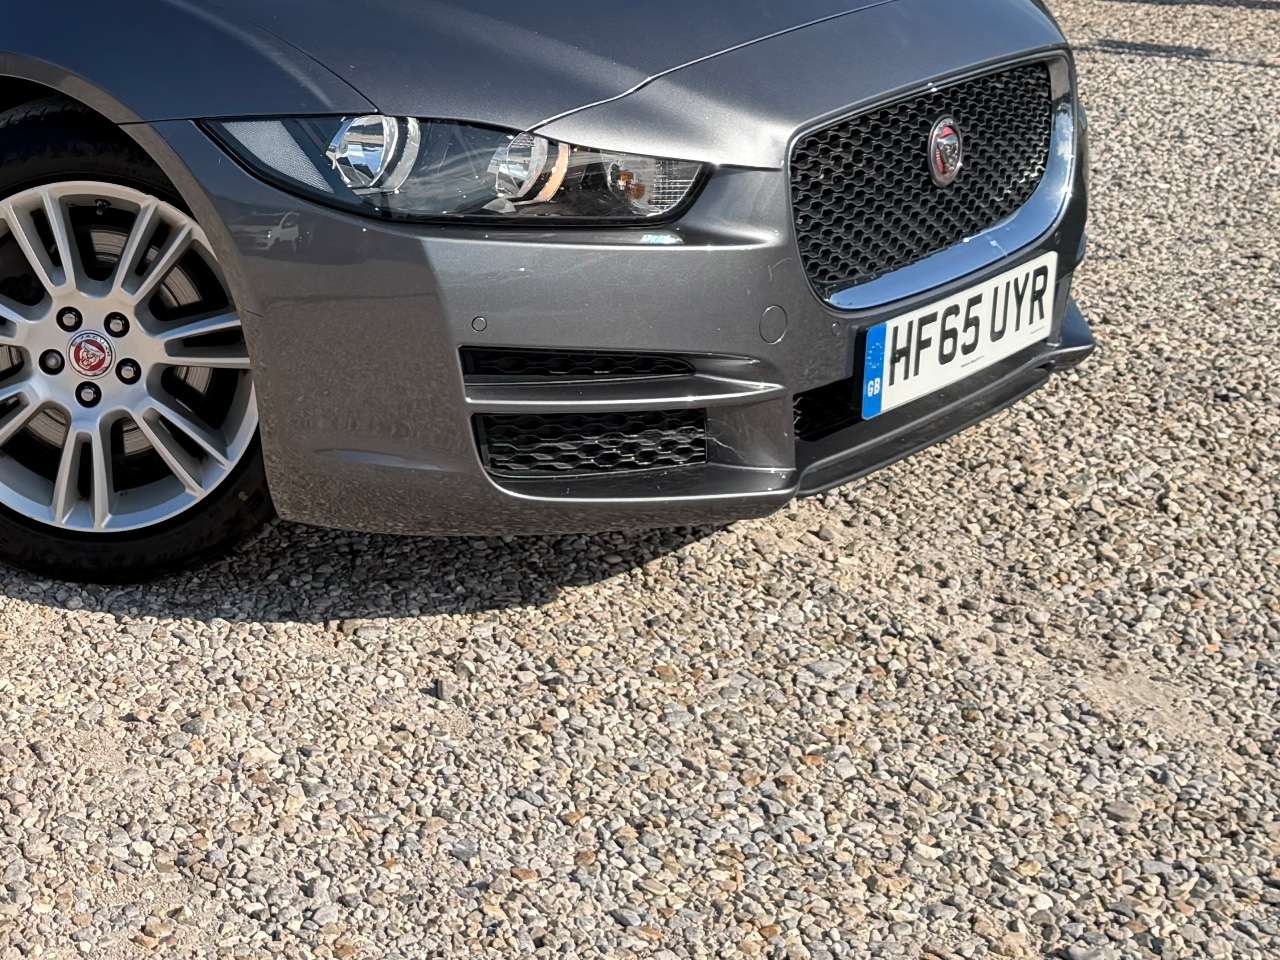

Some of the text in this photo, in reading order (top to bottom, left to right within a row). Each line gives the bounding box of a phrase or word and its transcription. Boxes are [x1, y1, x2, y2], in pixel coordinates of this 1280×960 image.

[888, 264, 1049, 387] HF65 UYR
[867, 377, 881, 398] GB
